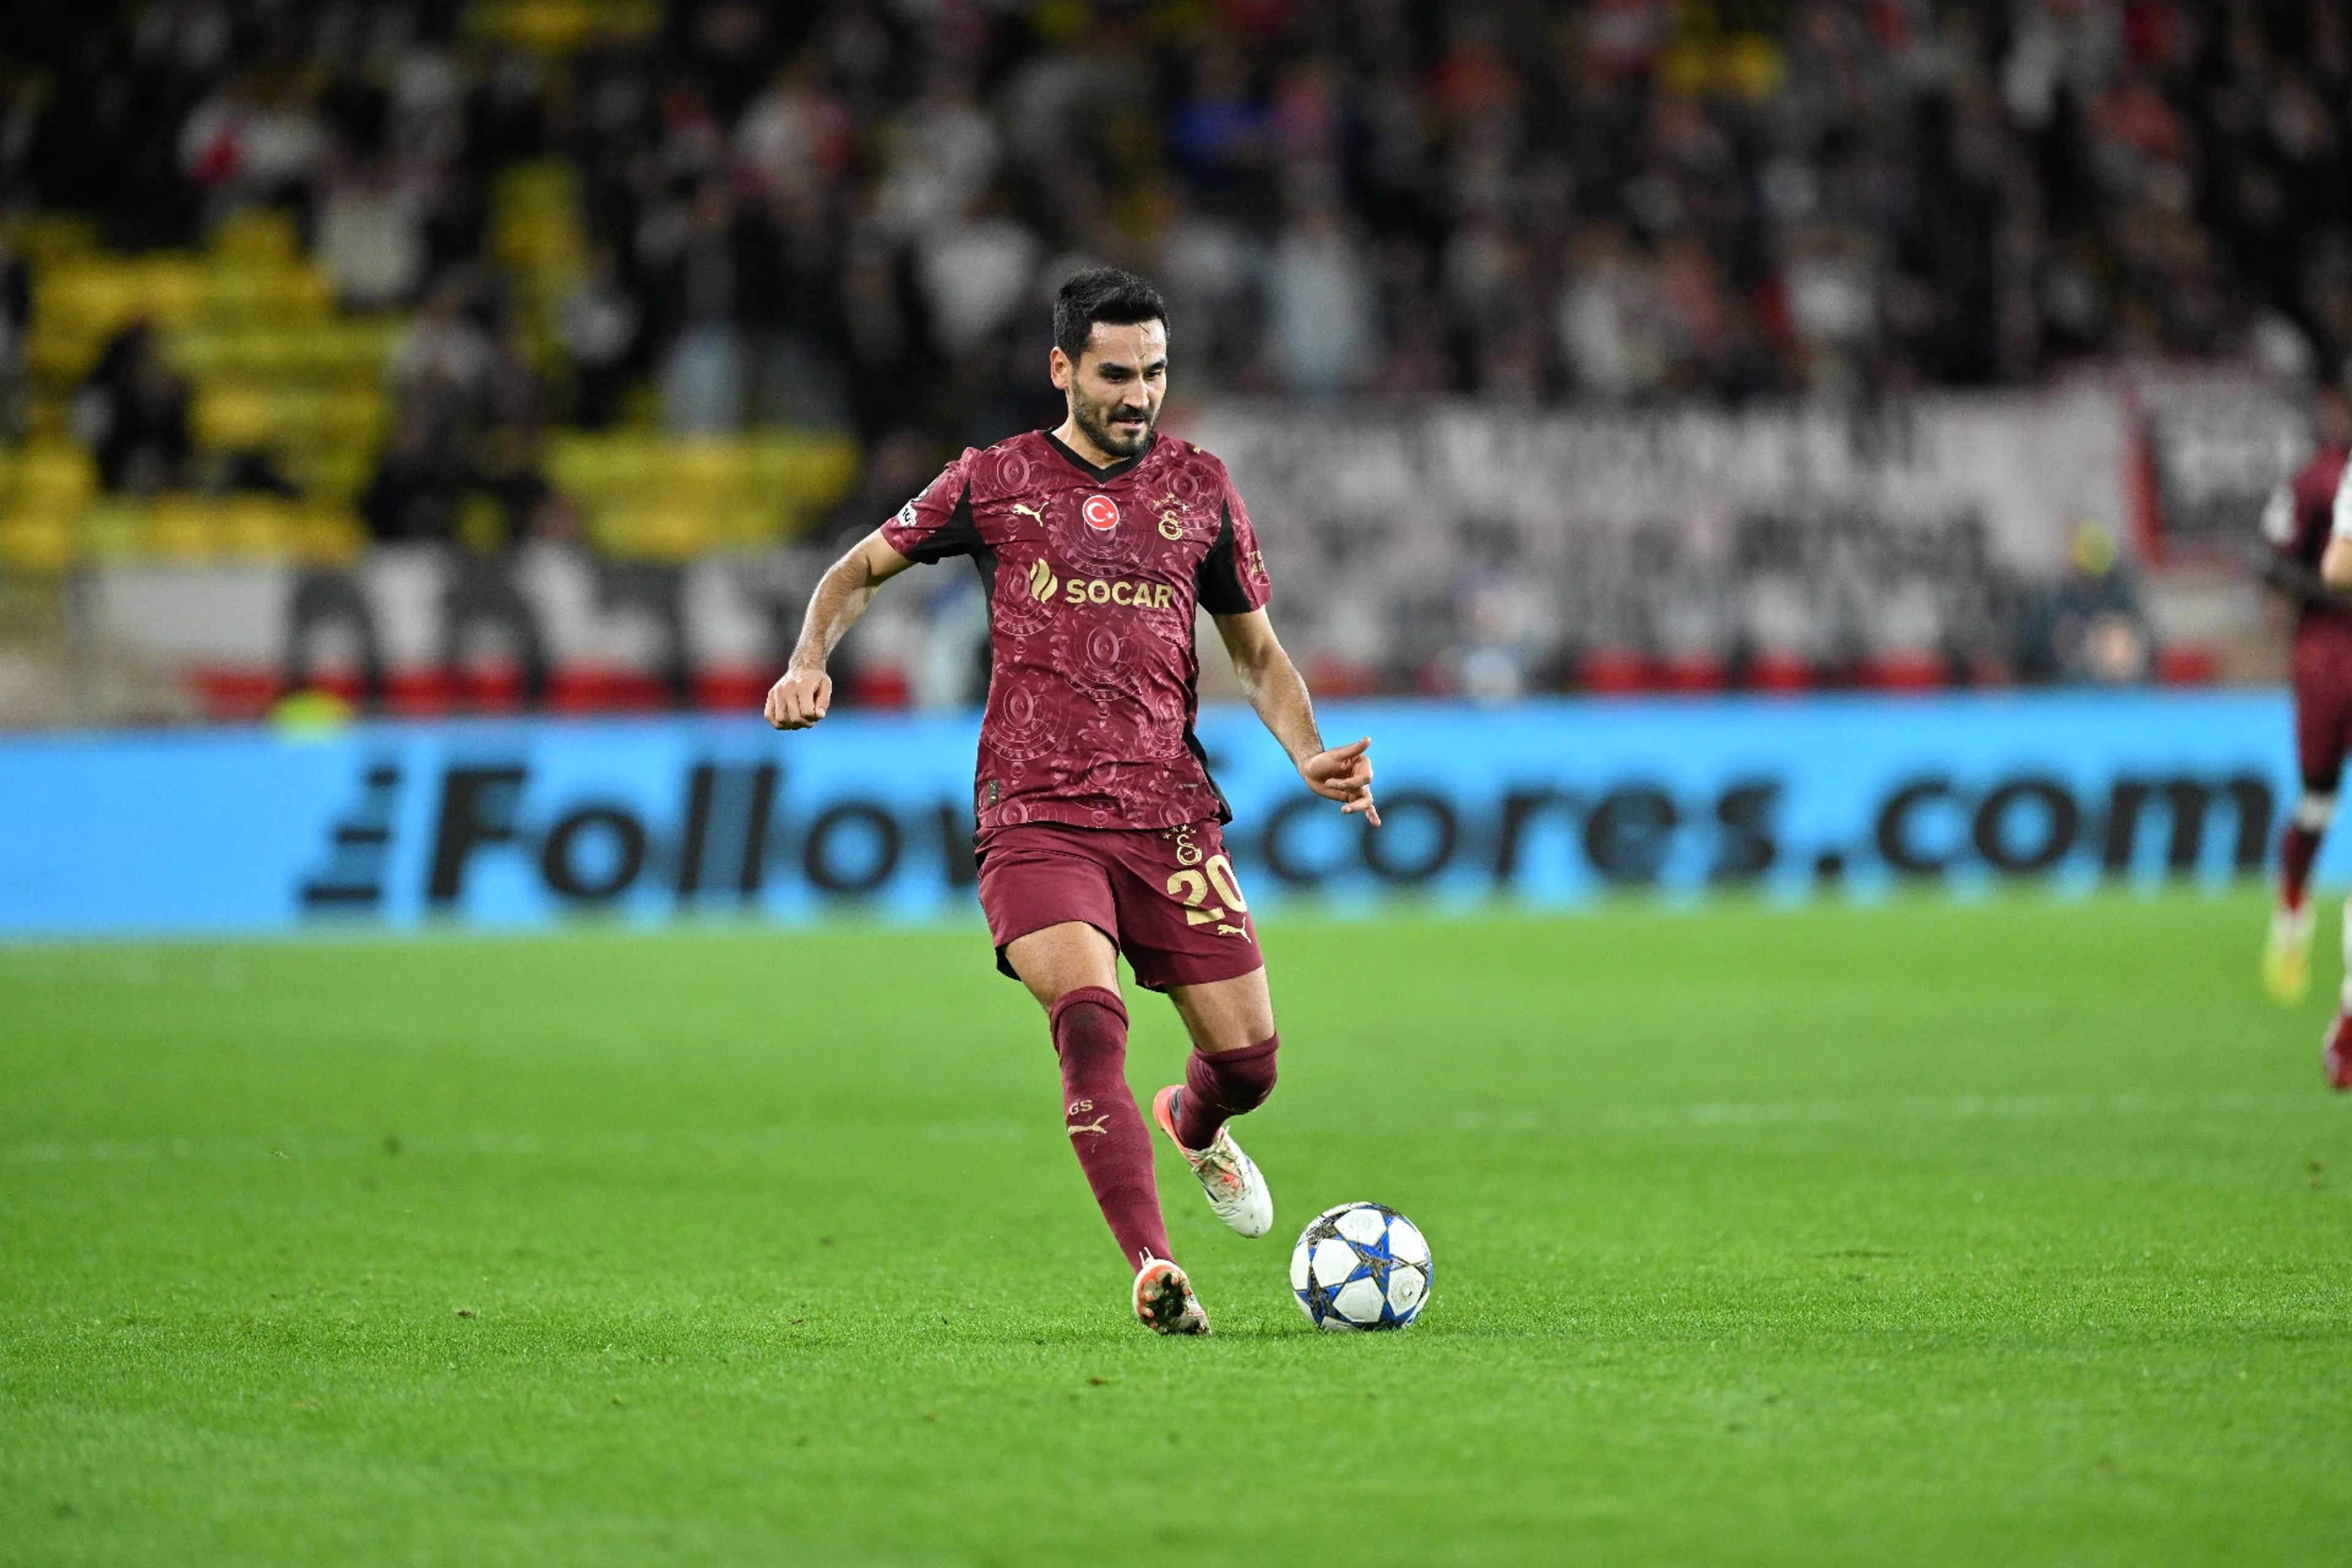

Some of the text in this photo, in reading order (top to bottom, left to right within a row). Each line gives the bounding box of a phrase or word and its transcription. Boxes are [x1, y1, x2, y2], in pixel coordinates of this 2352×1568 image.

[1065, 578, 1173, 608] SOCAR
[1167, 854, 1248, 925] 20
[1069, 1099, 1093, 1115] GS
